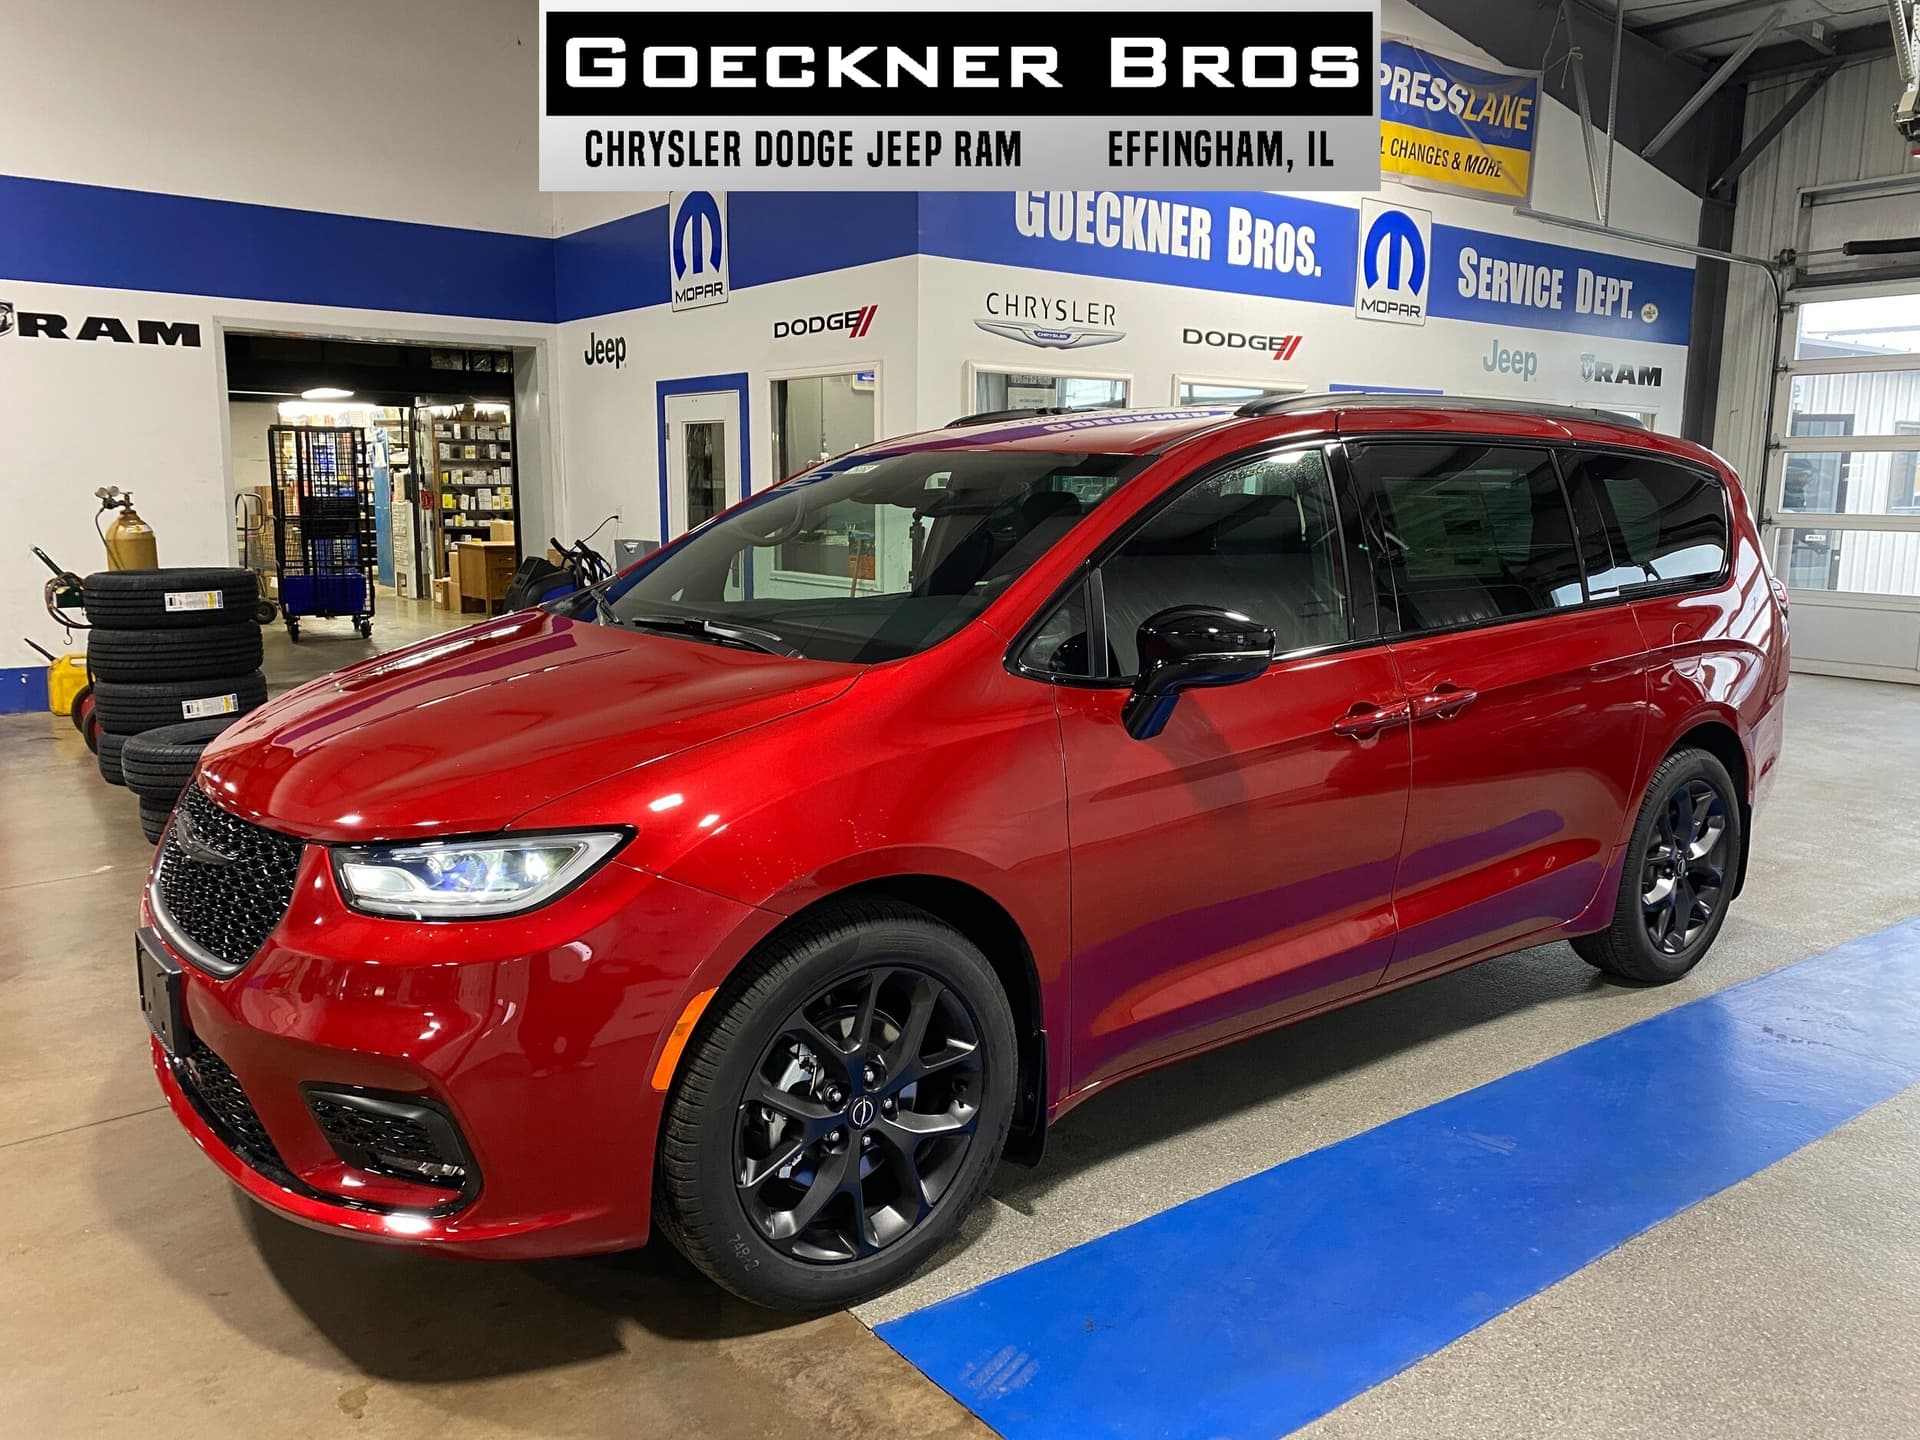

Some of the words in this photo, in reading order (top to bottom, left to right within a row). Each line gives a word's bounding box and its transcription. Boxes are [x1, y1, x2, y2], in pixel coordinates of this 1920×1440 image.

[1391, 138, 1449, 168] CHANGES
[1451, 152, 1460, 171] &
[1464, 155, 1502, 178] MORE
[1014, 191, 1212, 262] GOECKNER
[1227, 206, 1322, 277] BROS.
[675, 281, 724, 304] MOPAR
[1458, 246, 1563, 310] SERVICE
[1575, 268, 1633, 320] DEPT.
[774, 310, 861, 338] DODGE
[986, 292, 1116, 326] CHRYSLER
[1361, 298, 1421, 318] MOPAR
[17, 311, 202, 348] RAM
[1182, 328, 1286, 352] DODGE
[584, 332, 627, 369] Jeep
[1482, 339, 1538, 382] Jeep
[1594, 361, 1662, 387] RAM
